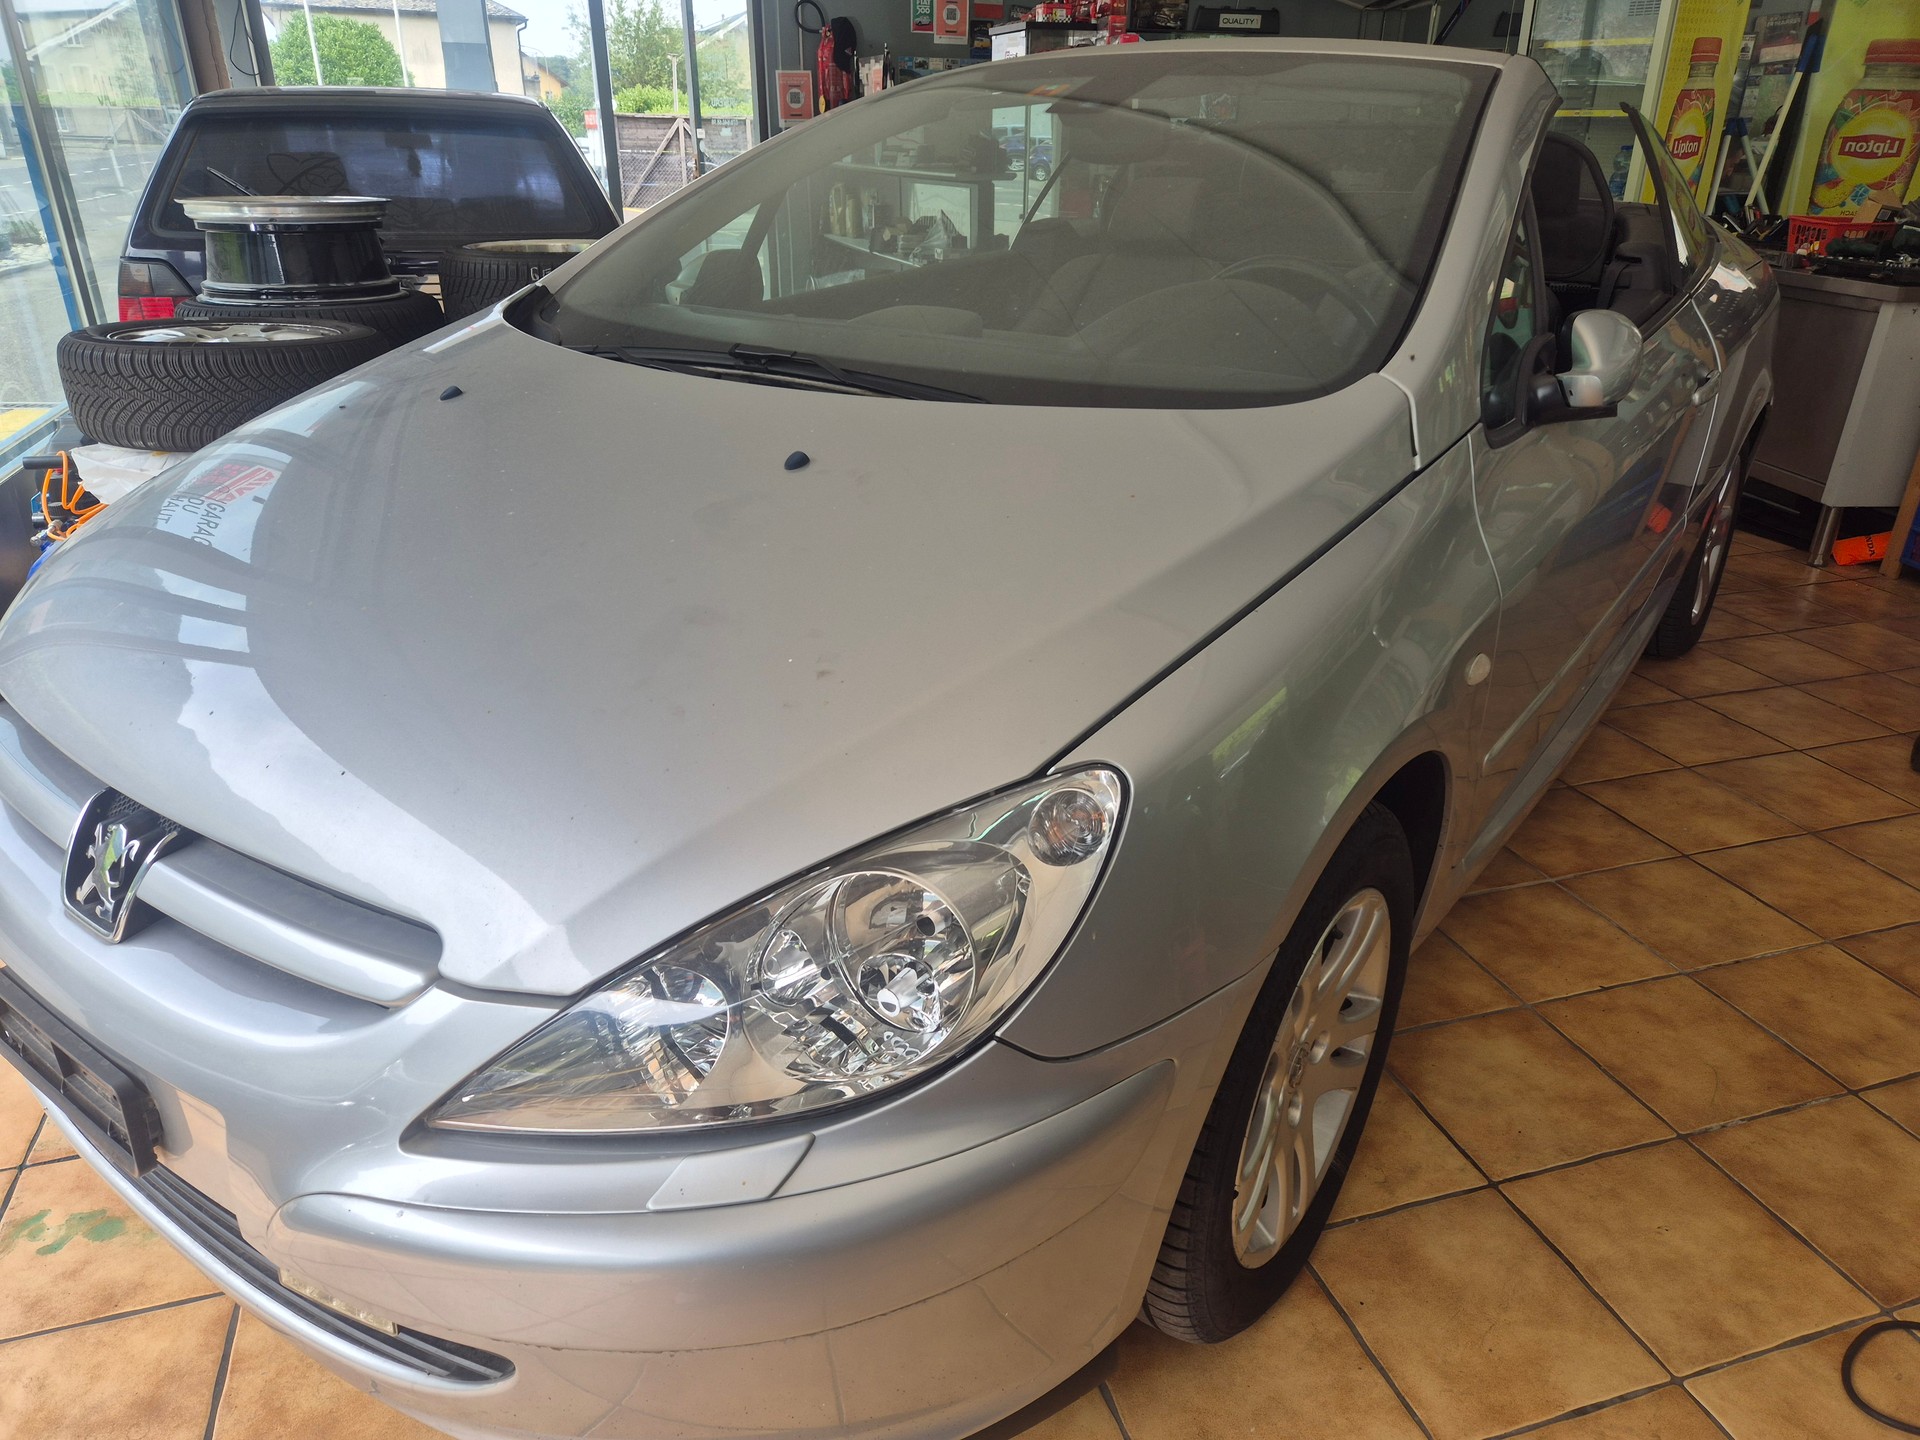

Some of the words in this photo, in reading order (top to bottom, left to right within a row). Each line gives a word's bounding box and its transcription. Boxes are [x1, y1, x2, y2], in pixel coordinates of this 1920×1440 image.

[1222, 17, 1255, 25] QUALITY
[1673, 140, 1699, 157] Lipton
[157, 494, 184, 524] HAUT
[182, 497, 206, 515] DU
